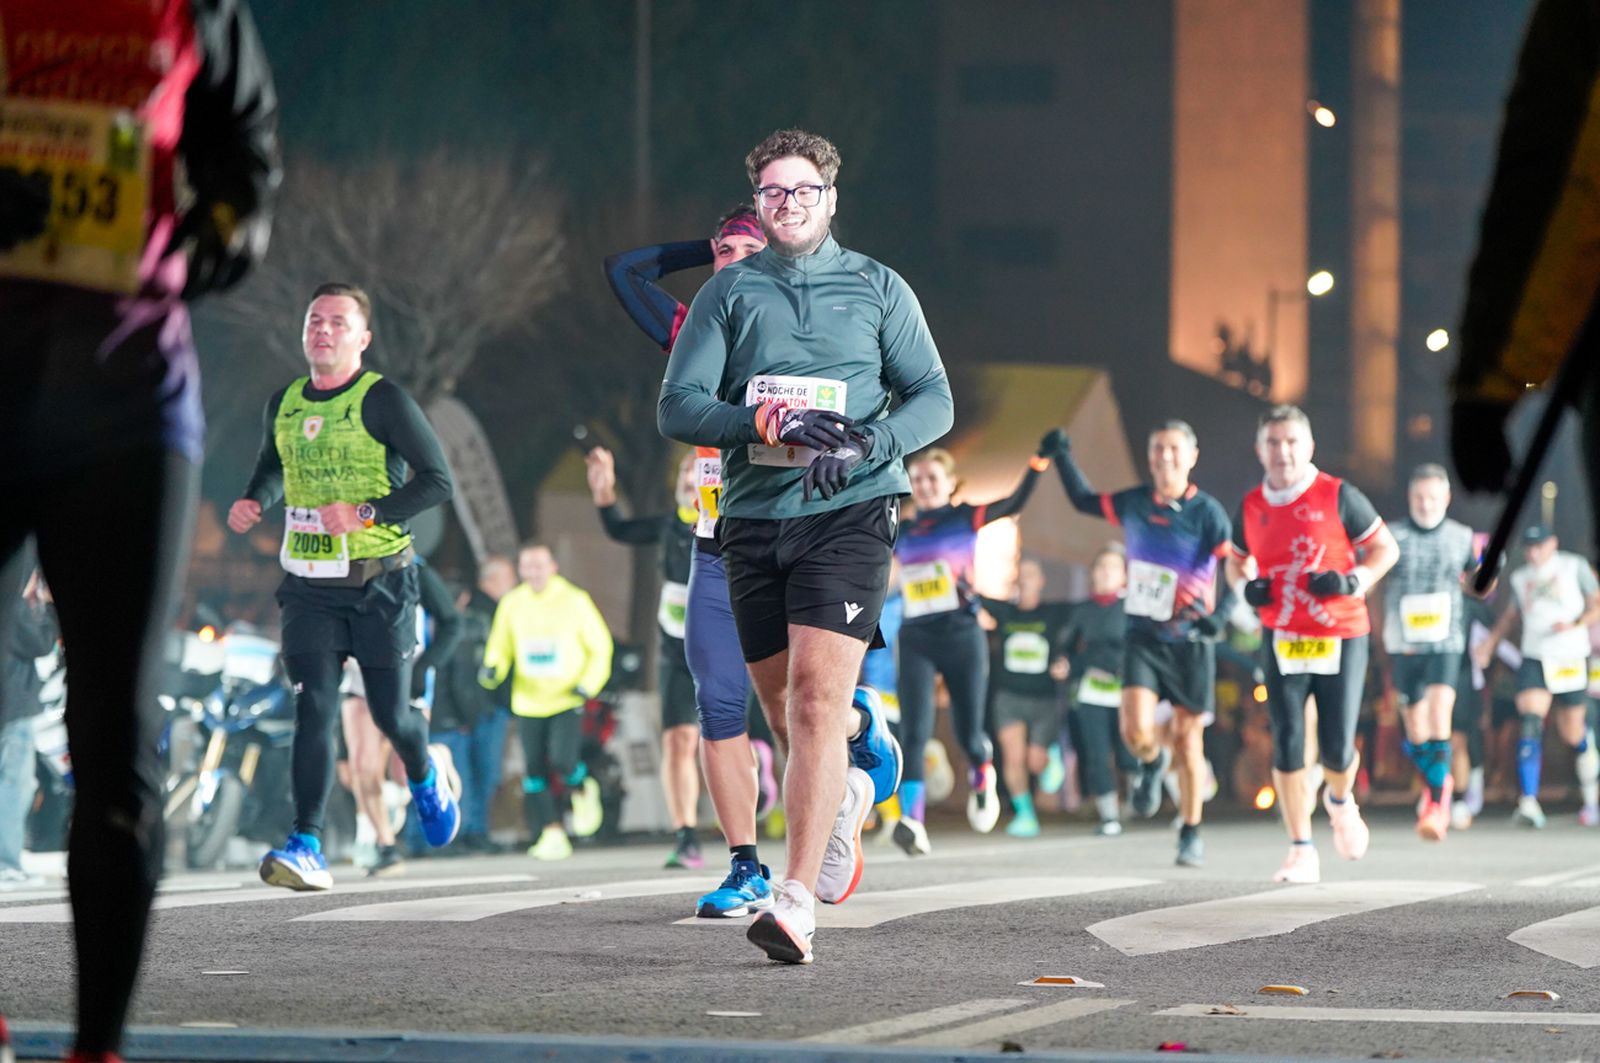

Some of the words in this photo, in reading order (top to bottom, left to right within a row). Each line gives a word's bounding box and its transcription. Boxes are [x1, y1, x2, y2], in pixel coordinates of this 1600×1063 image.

[767, 386, 795, 396] NOCHE
[797, 387, 808, 397] DE
[293, 532, 333, 554] 2009
